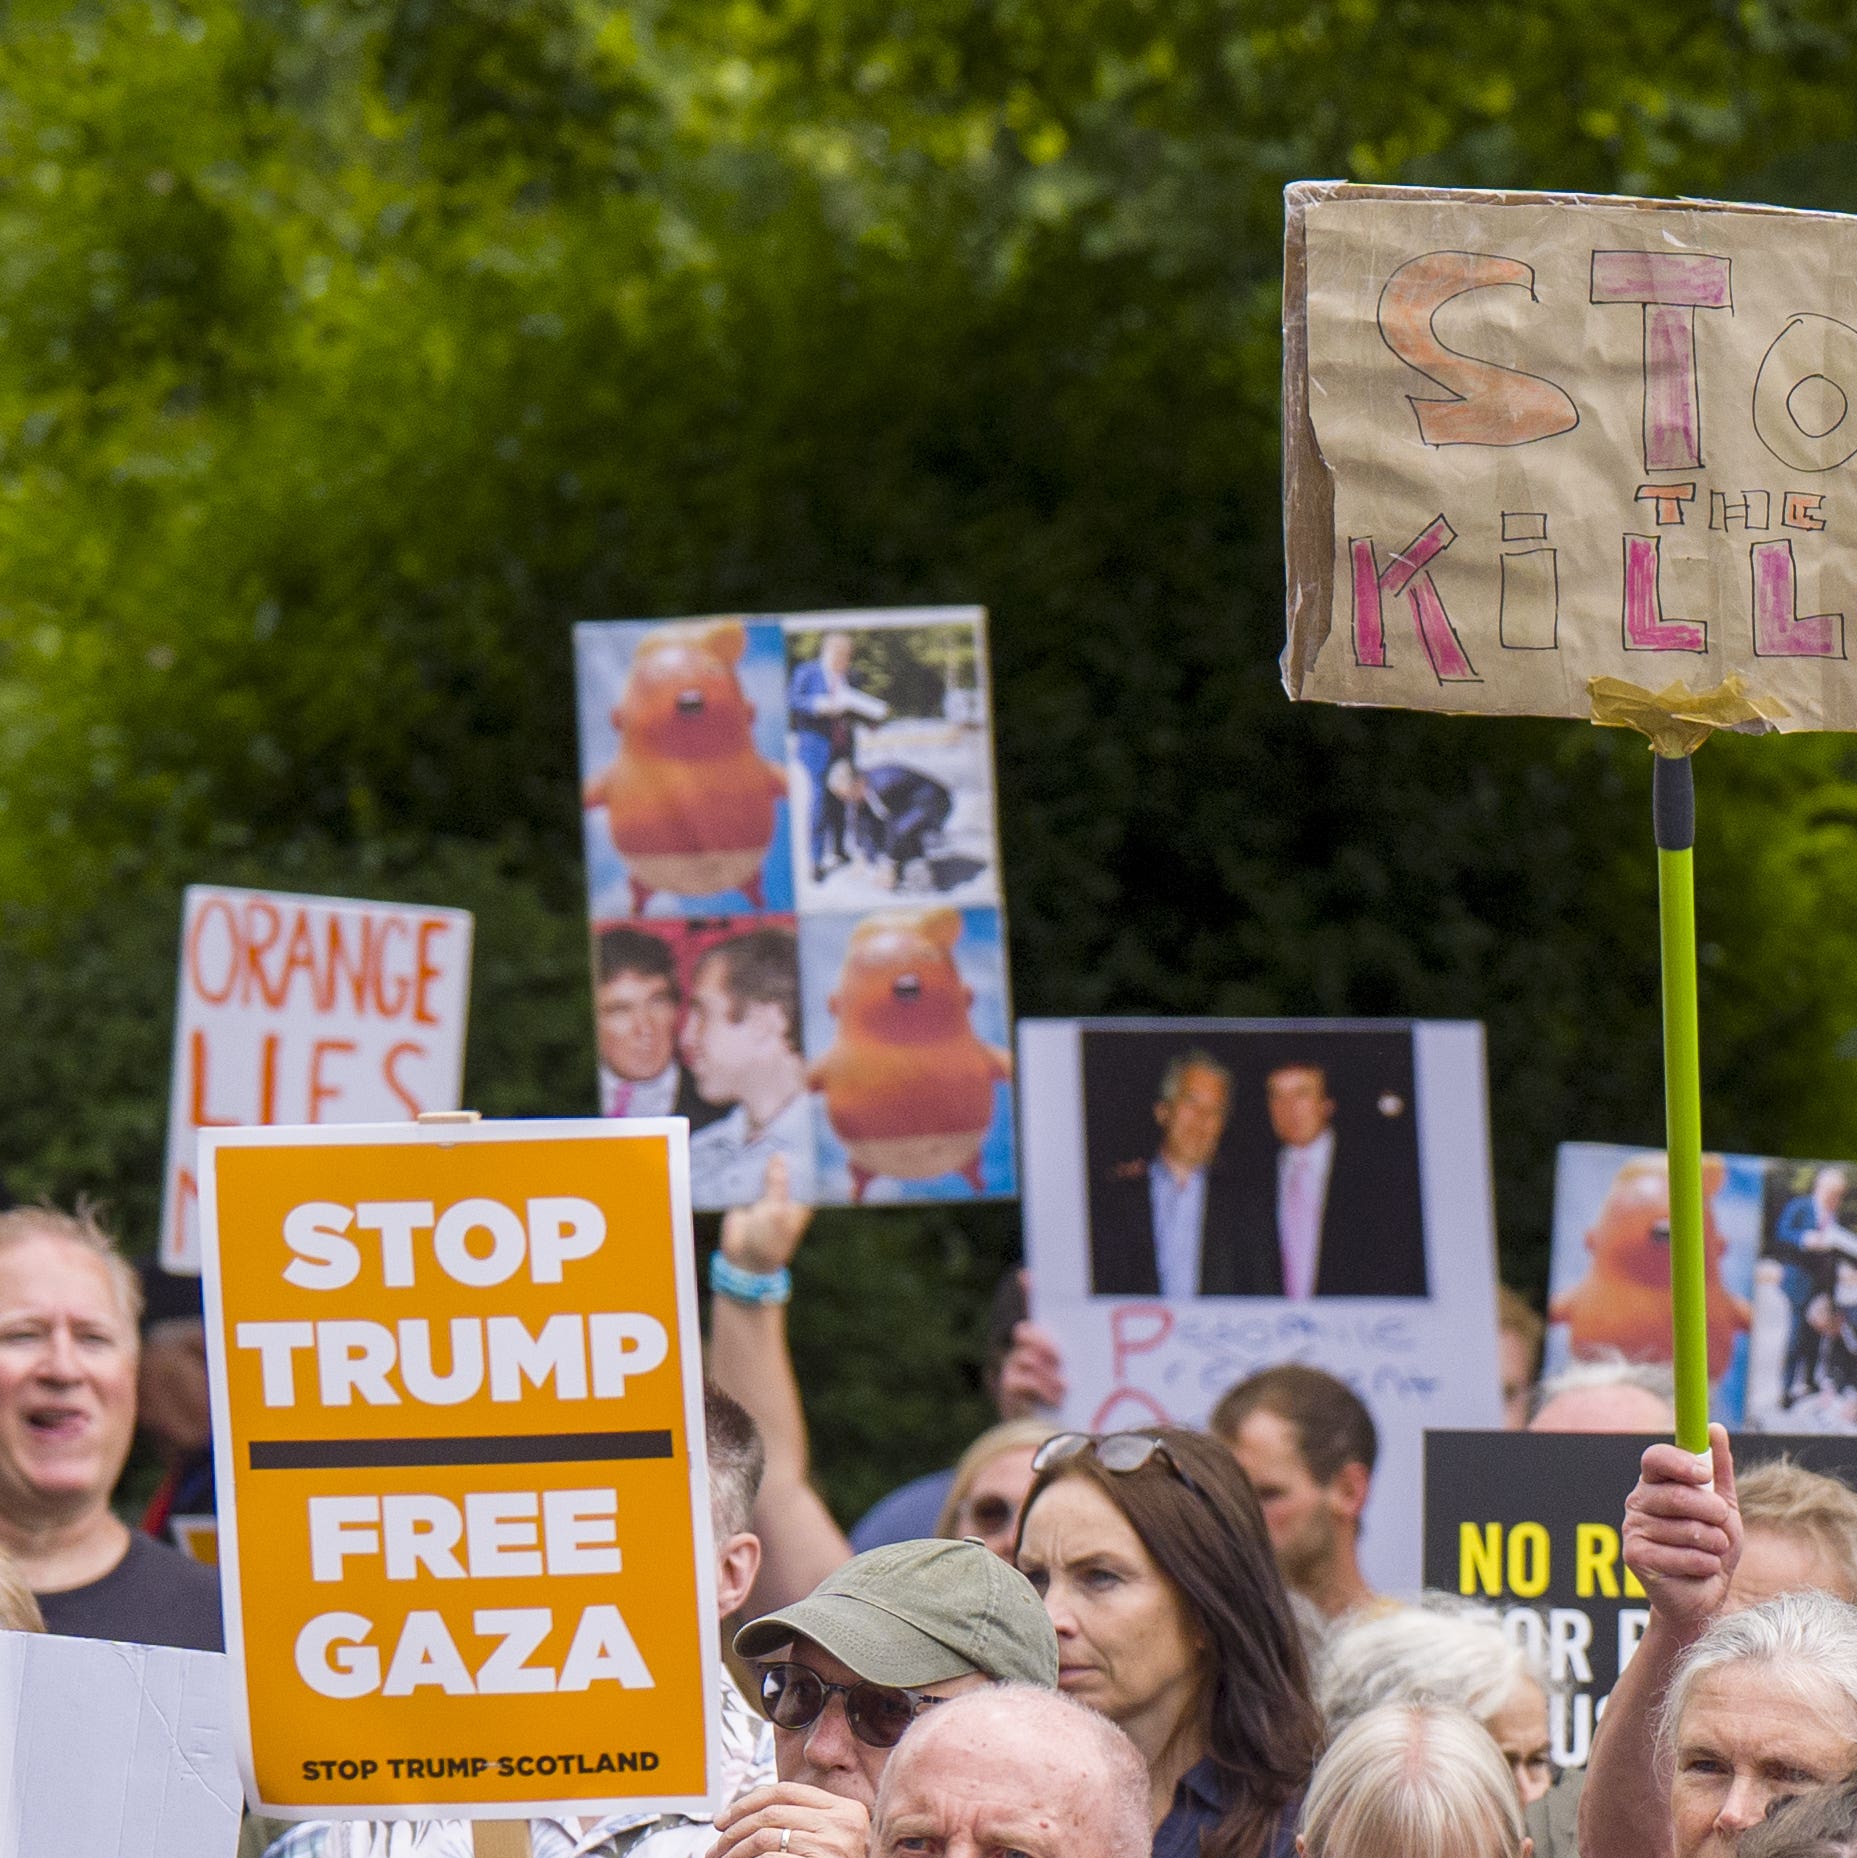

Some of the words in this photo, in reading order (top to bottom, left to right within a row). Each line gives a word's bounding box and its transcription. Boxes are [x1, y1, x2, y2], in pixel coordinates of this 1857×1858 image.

[1635, 483, 1827, 532] THE
[188, 897, 450, 1027] ORANGE
[282, 1196, 606, 1291] STOP
[236, 1312, 669, 1407] TRUMP
[309, 1489, 622, 1582] FREE
[1459, 1521, 1550, 1598] NO
[295, 1605, 655, 1699] GAZA
[302, 1760, 378, 1781] STOP
[388, 1757, 489, 1779] TRUMP
[498, 1751, 659, 1777] SCOTLAND
